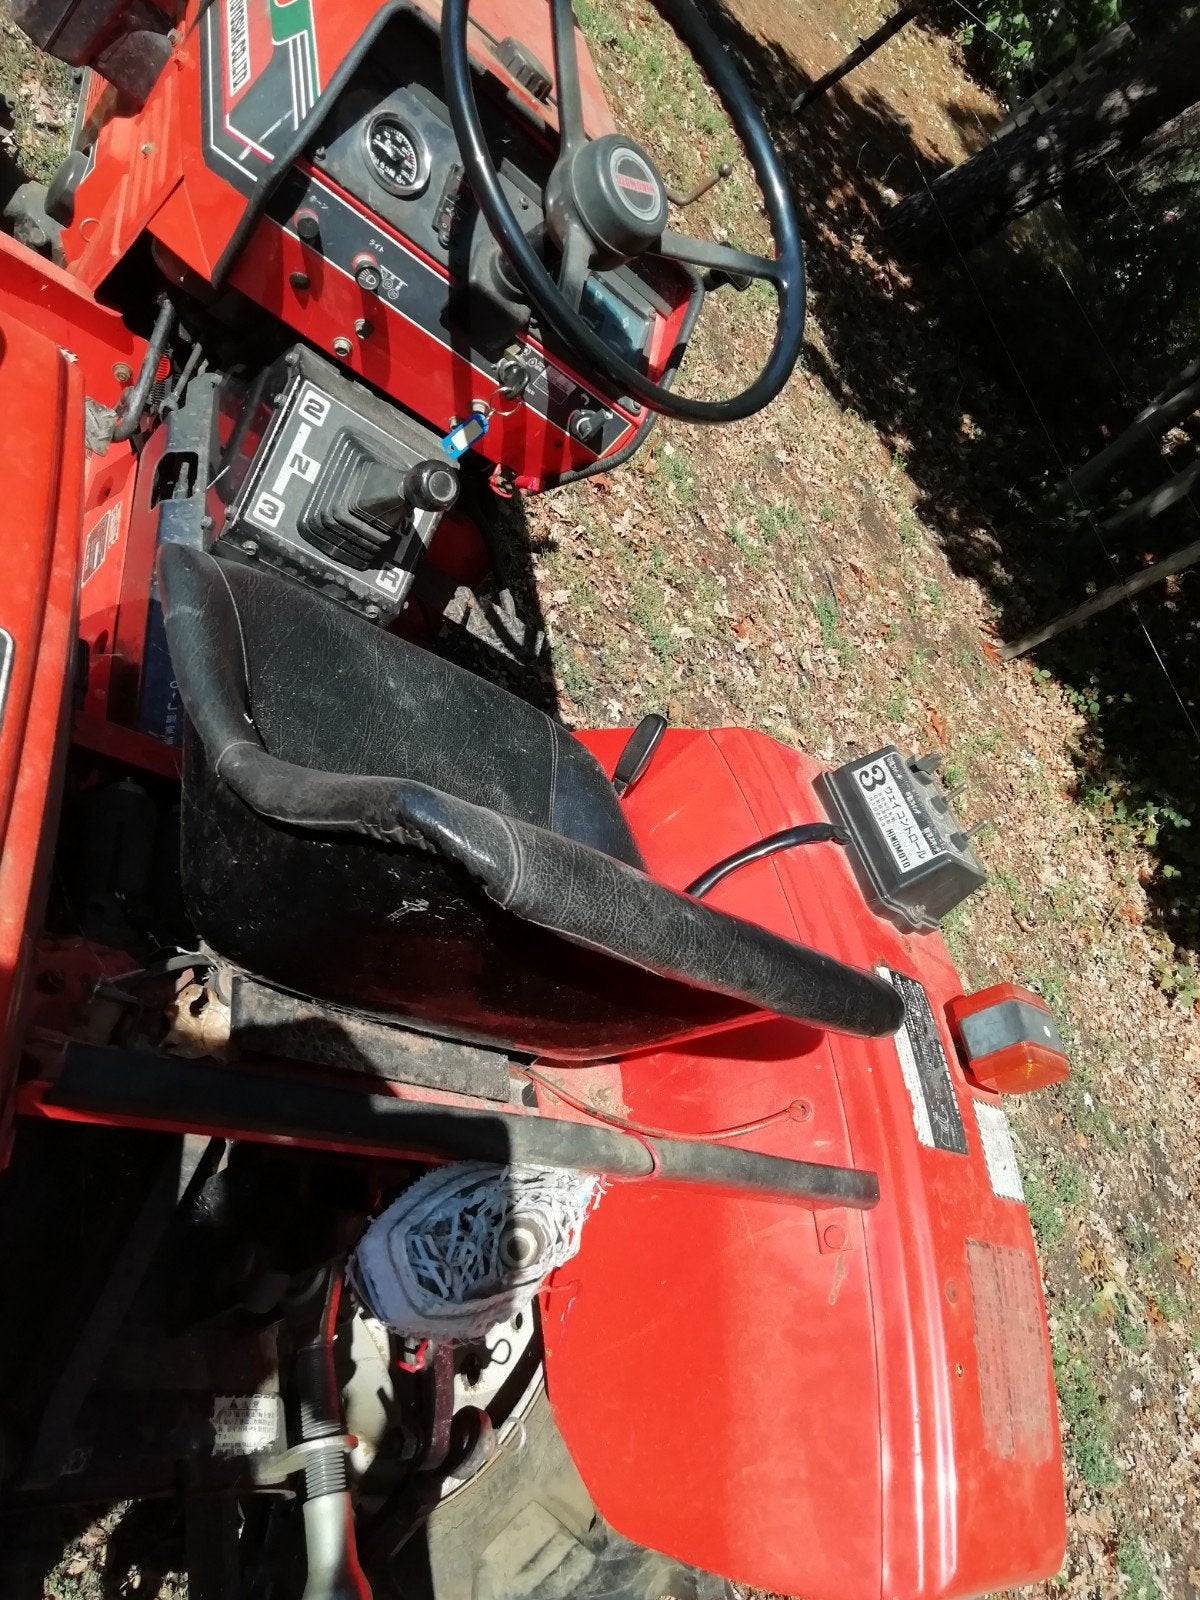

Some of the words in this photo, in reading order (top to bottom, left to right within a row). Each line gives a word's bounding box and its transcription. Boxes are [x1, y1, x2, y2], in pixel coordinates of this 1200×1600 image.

[229, 0, 247, 48] OYOSHA
[303, 396, 326, 421] 2
[290, 455, 311, 474] N
[257, 498, 280, 520] 3
[380, 568, 402, 588] R
[858, 765, 887, 792] 3
[885, 828, 912, 869] HINOMOTO
